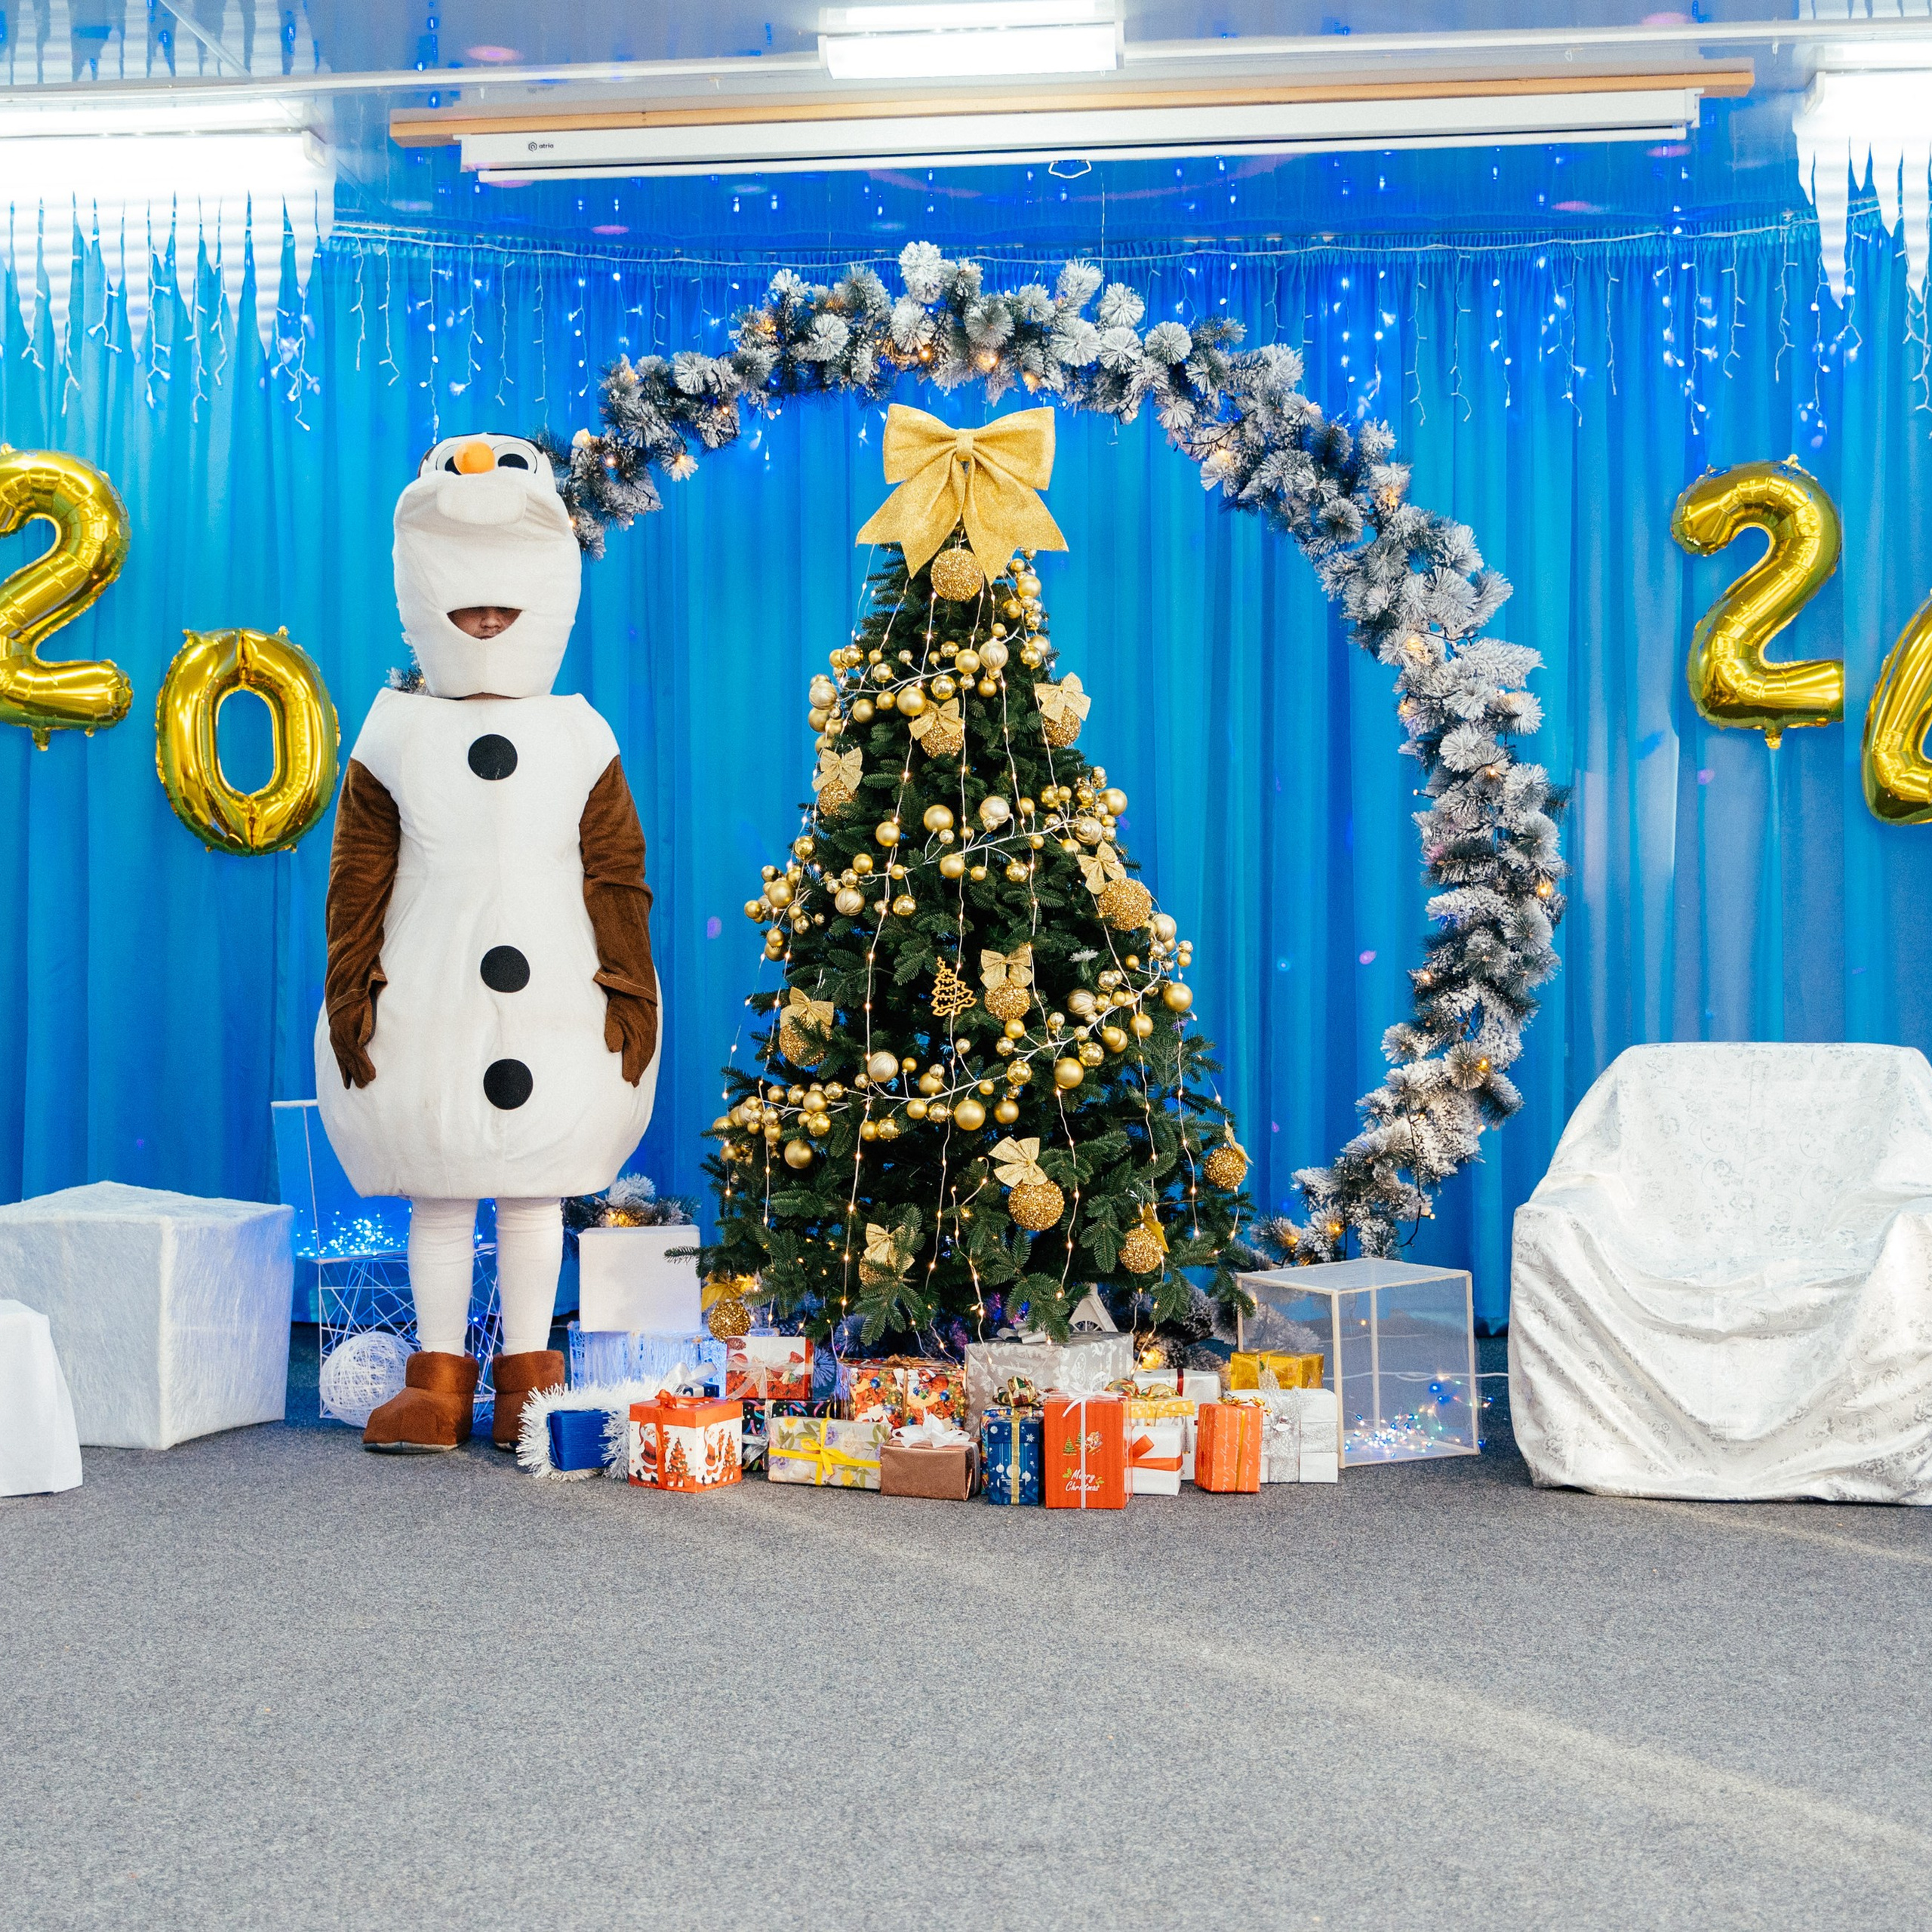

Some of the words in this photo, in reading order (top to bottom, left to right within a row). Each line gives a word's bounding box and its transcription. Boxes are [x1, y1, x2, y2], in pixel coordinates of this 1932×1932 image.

[0, 447, 133, 734] 2
[1671, 457, 1844, 731] 2
[155, 626, 341, 857] 0
[1065, 1481, 1100, 1491] Chritmas
[1070, 1469, 1097, 1484] Mery
